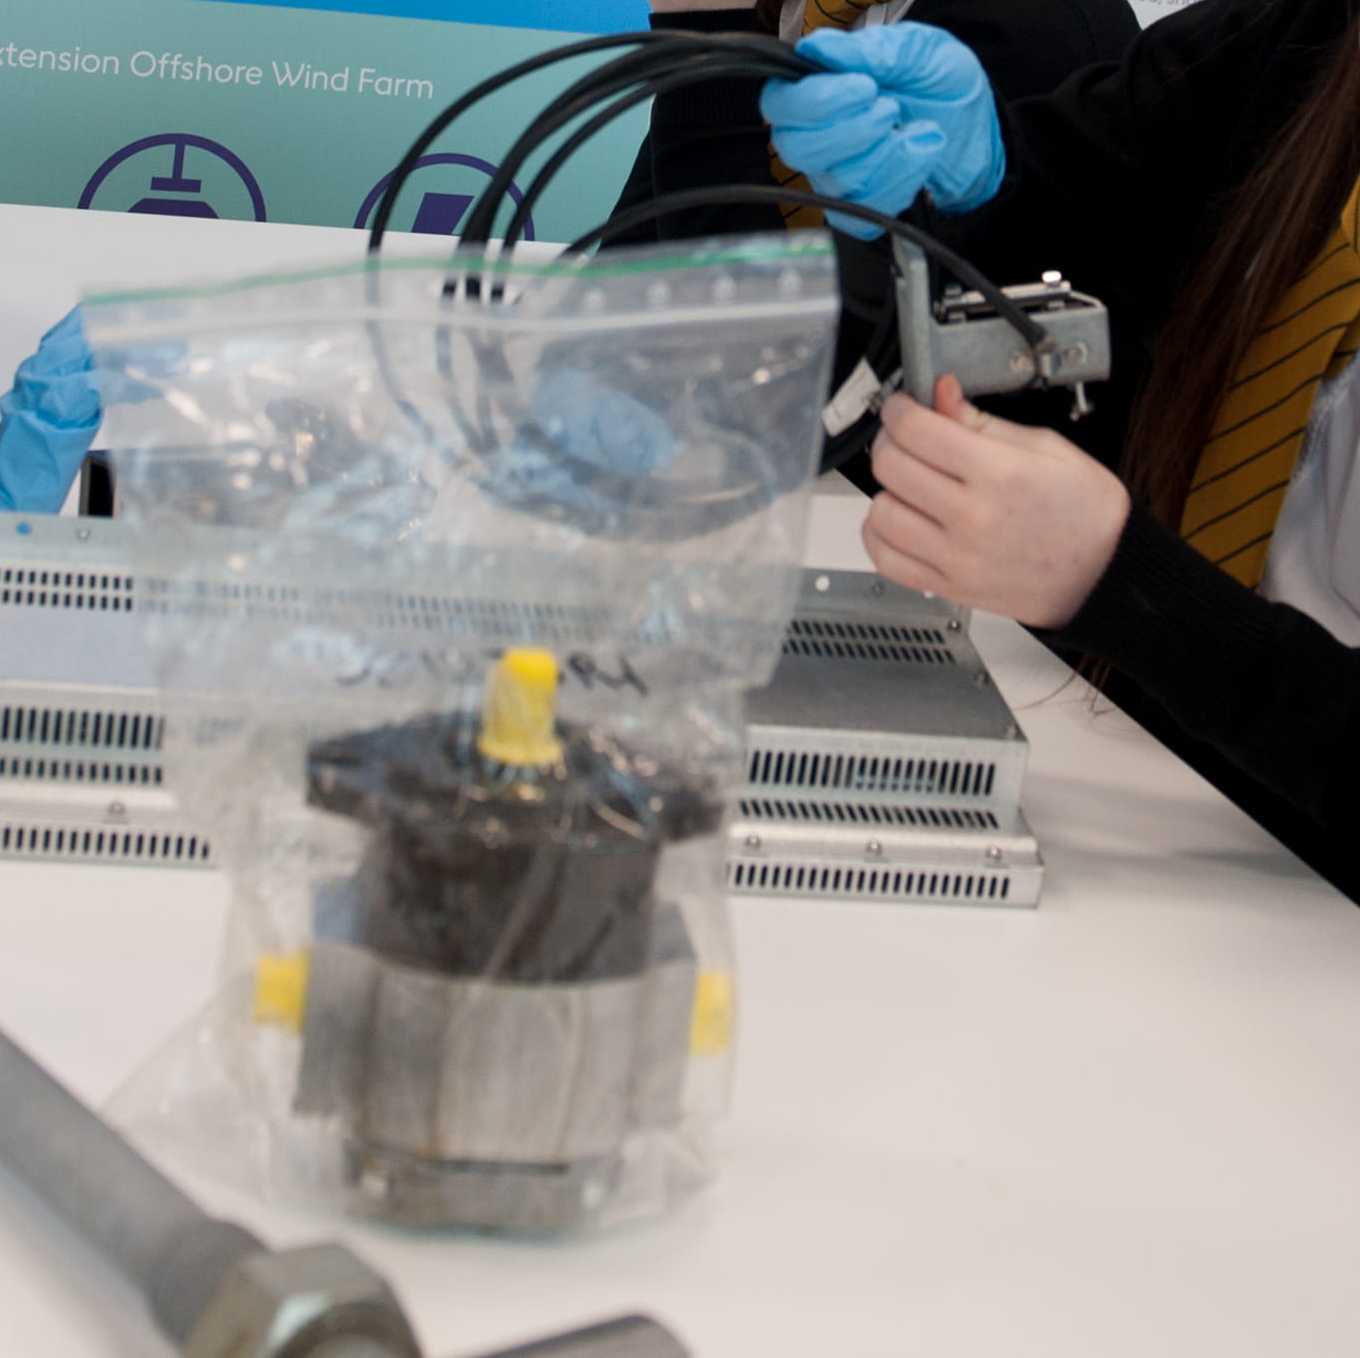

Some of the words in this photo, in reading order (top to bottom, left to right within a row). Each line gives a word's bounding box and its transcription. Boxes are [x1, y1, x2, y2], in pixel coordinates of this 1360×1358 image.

[130, 51, 262, 84] Offshore
[272, 62, 349, 91] Wind
[359, 68, 433, 98] Farm
